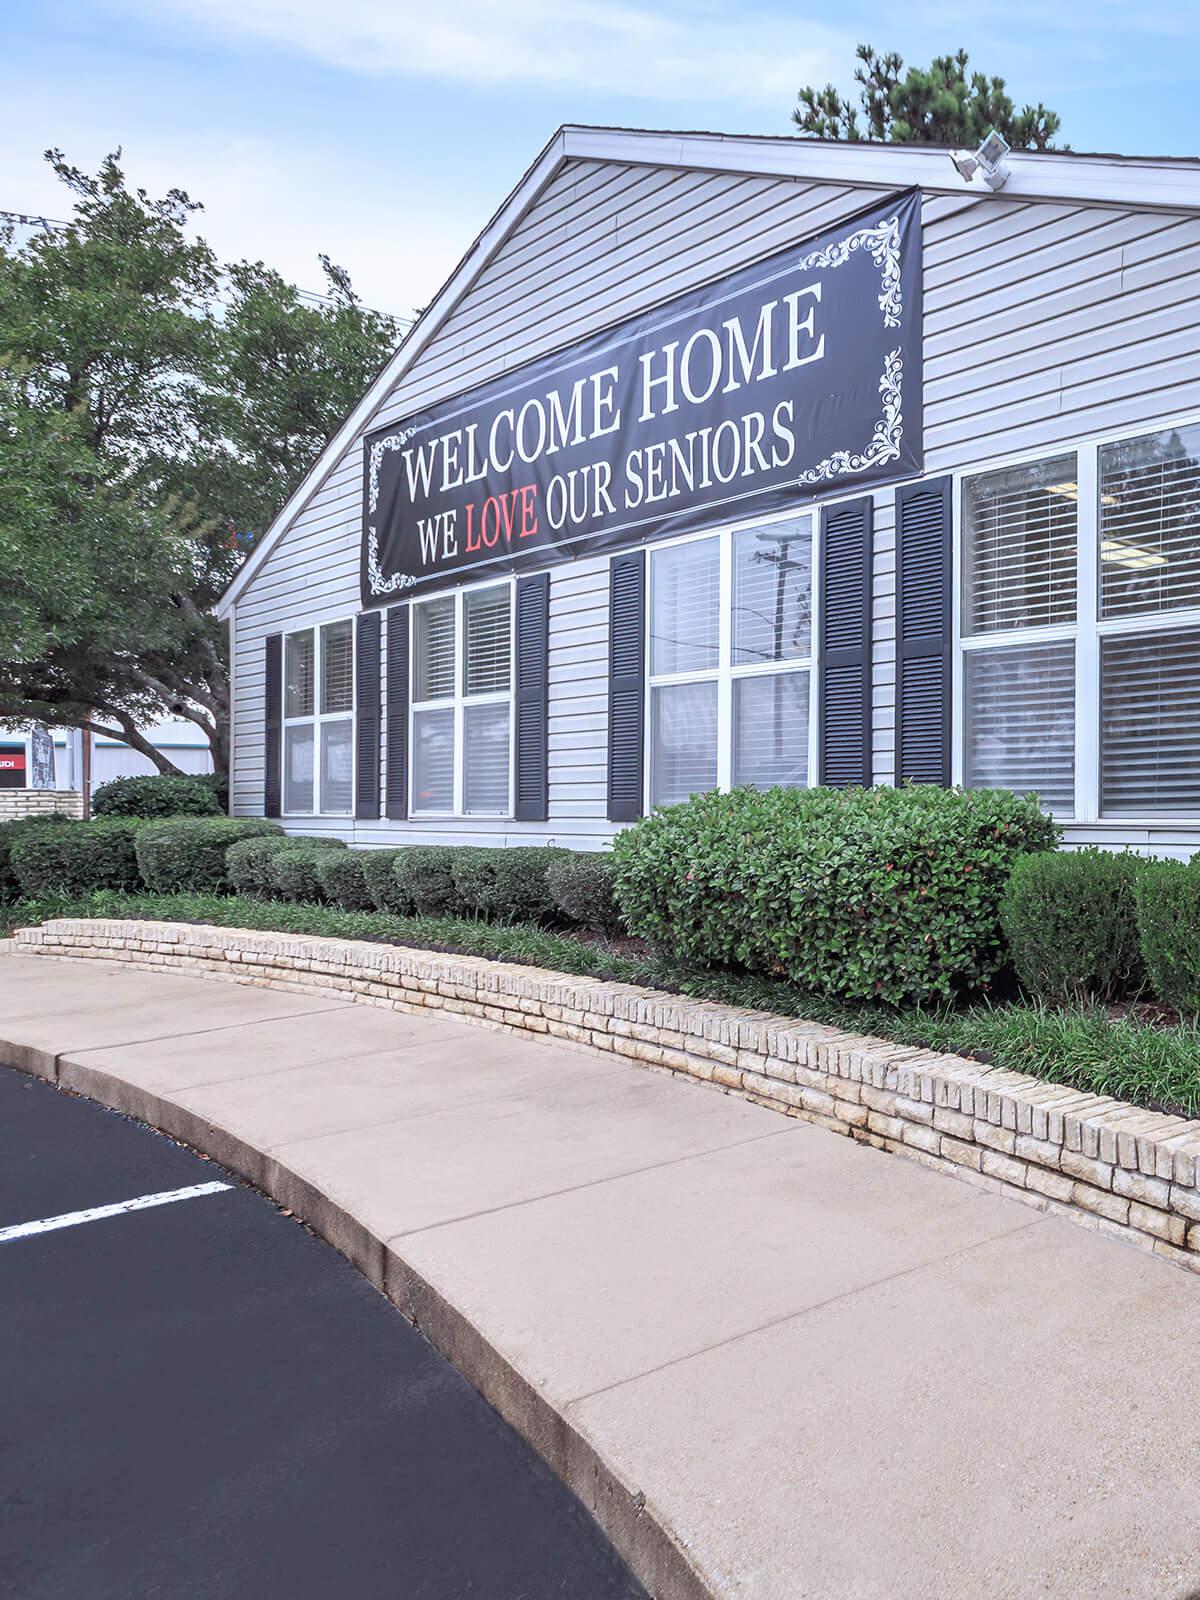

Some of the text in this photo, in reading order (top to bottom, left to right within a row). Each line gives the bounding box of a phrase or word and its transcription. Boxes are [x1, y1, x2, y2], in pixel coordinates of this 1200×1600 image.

[402, 282, 826, 503] WELCOME HOME
[417, 400, 796, 565] WE LOVE OUR SENIORS
